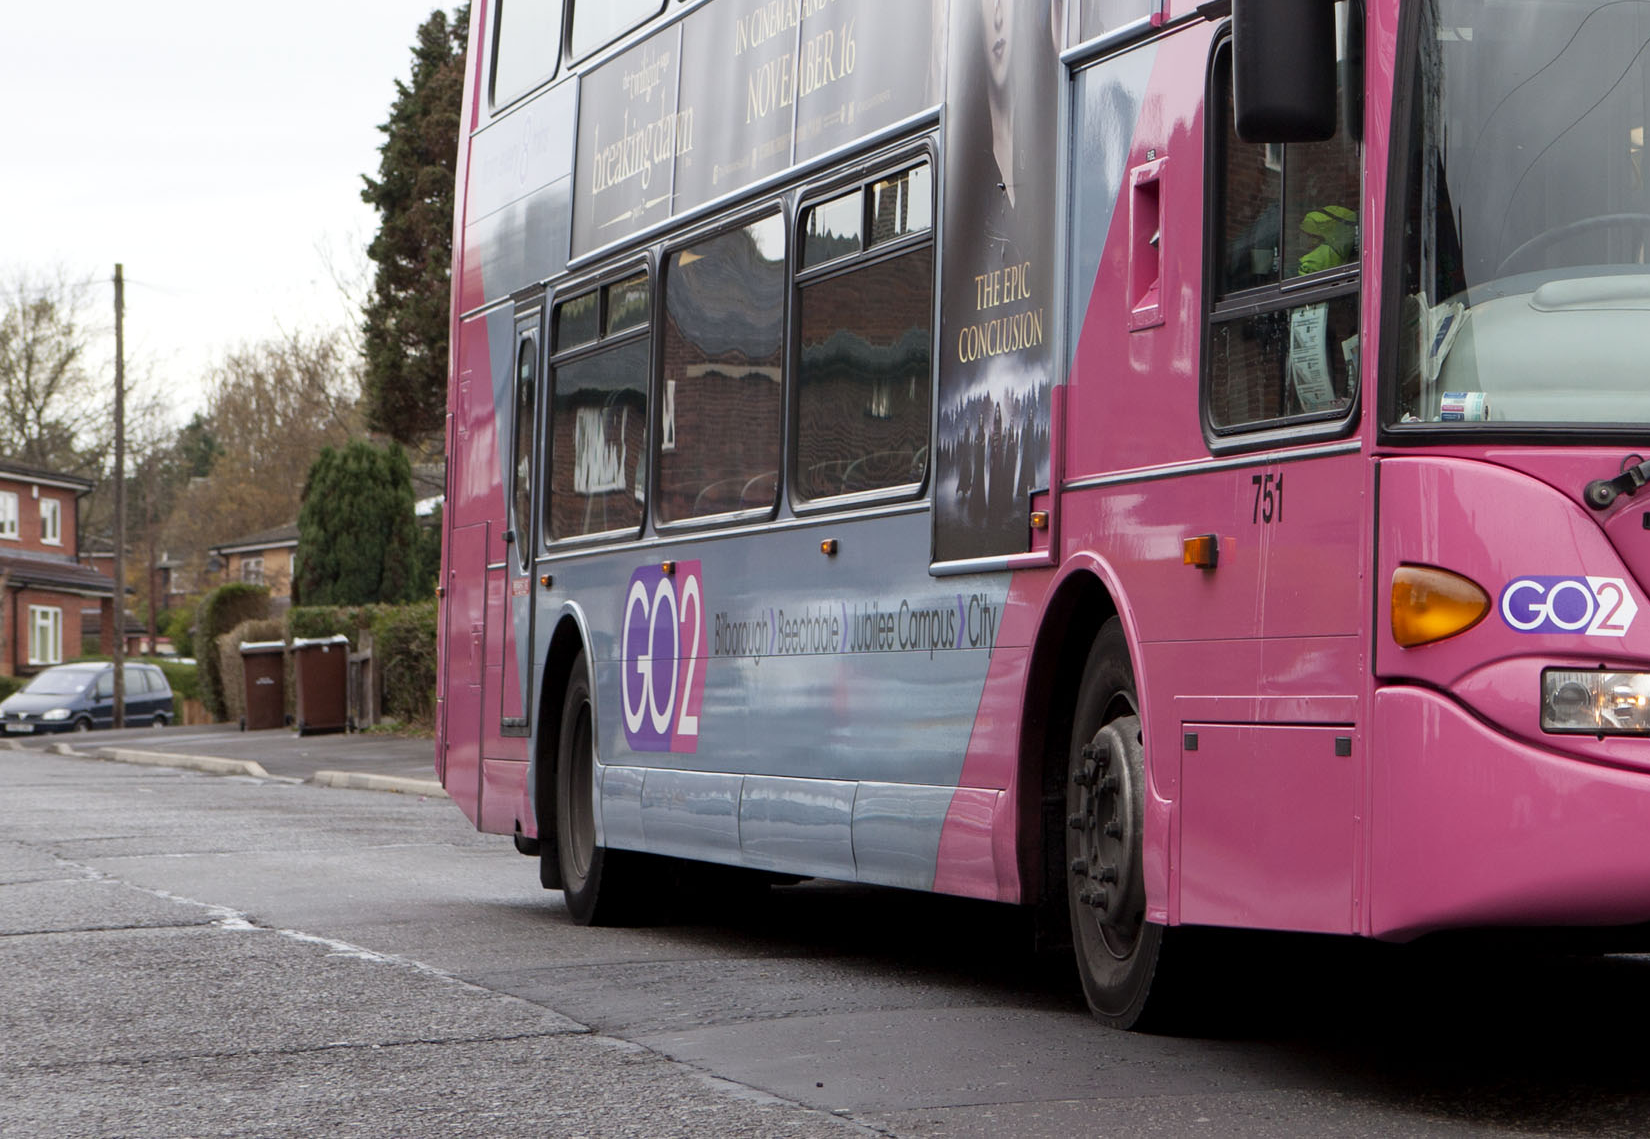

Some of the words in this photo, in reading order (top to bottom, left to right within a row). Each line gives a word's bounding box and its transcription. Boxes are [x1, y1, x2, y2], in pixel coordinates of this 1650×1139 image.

[735, 15, 749, 55] IN
[838, 16, 857, 79] 16
[591, 123, 653, 195] breaking
[974, 269, 1001, 311] THE
[1003, 261, 1031, 304] EPIC
[958, 308, 1044, 364] CONCLUSION
[1252, 472, 1283, 525] 751
[714, 607, 769, 666] Bilborough
[777, 605, 839, 653] Beechdale
[850, 601, 894, 652] Jubilee
[899, 598, 955, 660] Campus
[967, 593, 997, 660] City
[1502, 580, 1625, 631] GO2
[621, 573, 702, 736] GO2
